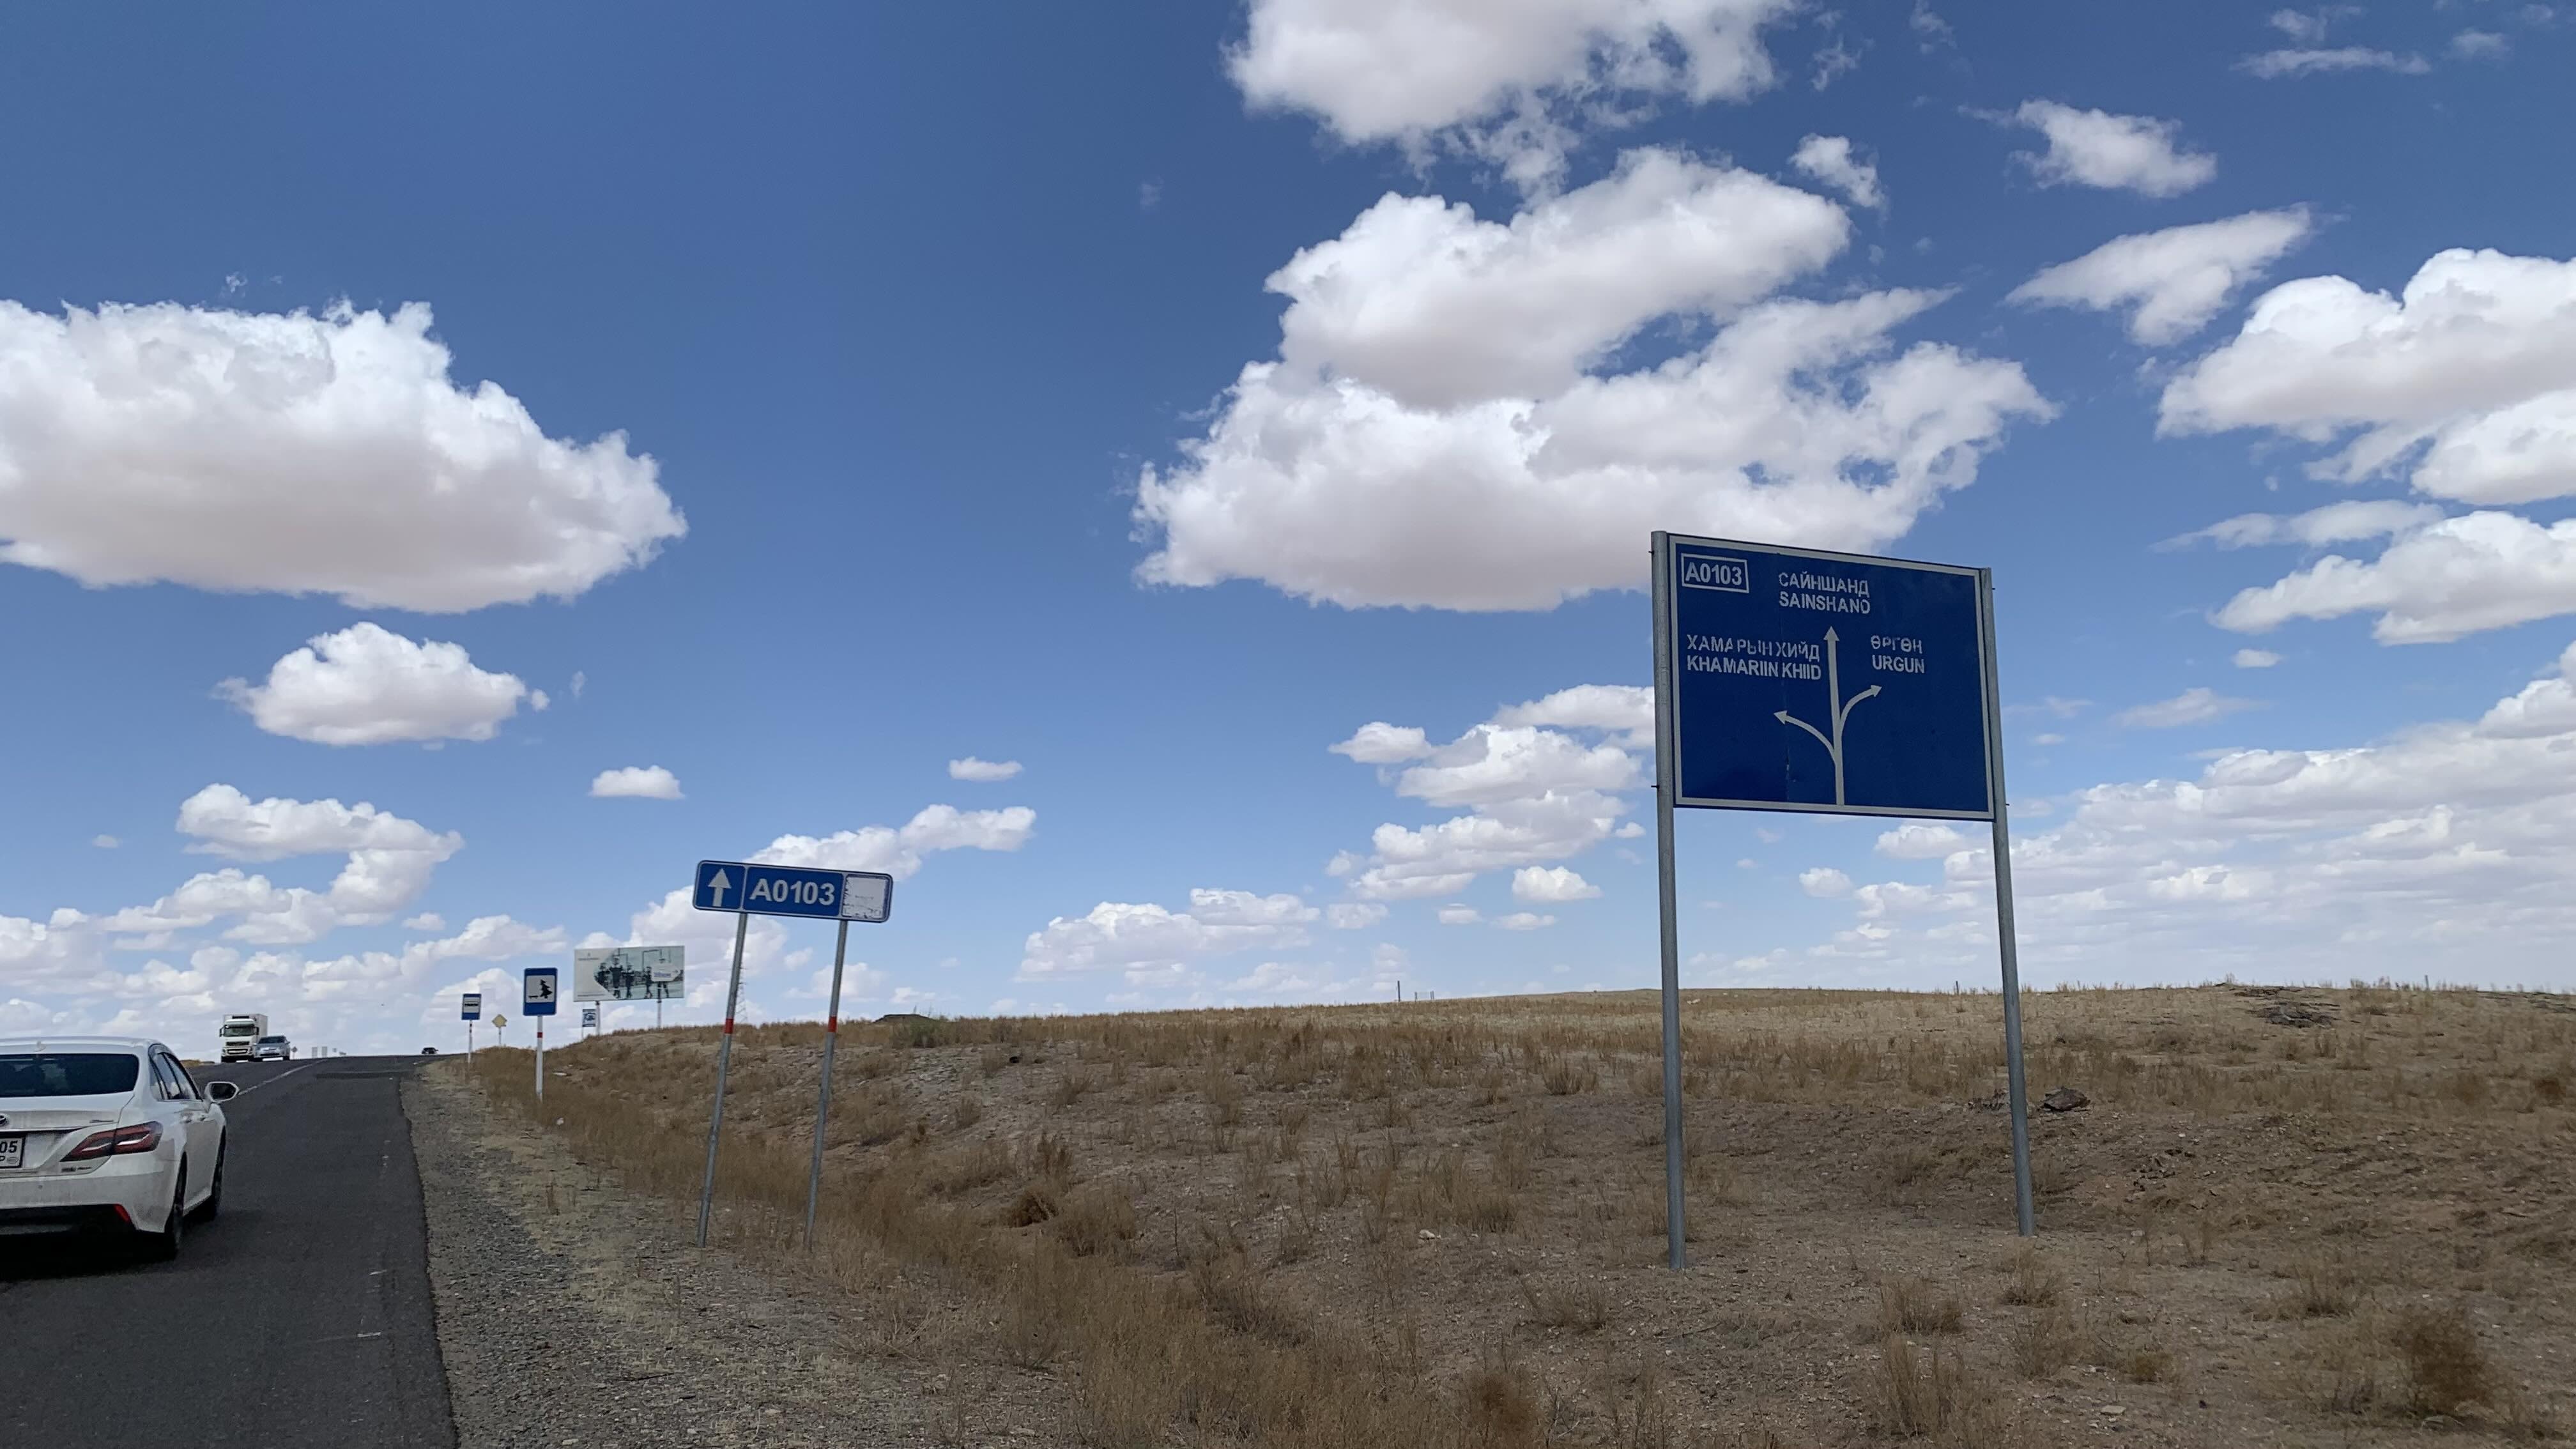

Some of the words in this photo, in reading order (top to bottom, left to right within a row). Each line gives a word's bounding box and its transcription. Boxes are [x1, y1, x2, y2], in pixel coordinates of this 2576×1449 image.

[1685, 562, 1742, 585] A0103
[1779, 571, 1869, 598] САЙНШАНД
[1776, 641, 1820, 663] ХИЙД
[1871, 634, 1922, 654] ӨРГӨН
[1687, 655, 1779, 677] KHAMARIIN
[1782, 662, 1821, 680] KHIID
[1872, 654, 1924, 673] URGUN
[749, 878, 835, 905] A0103
